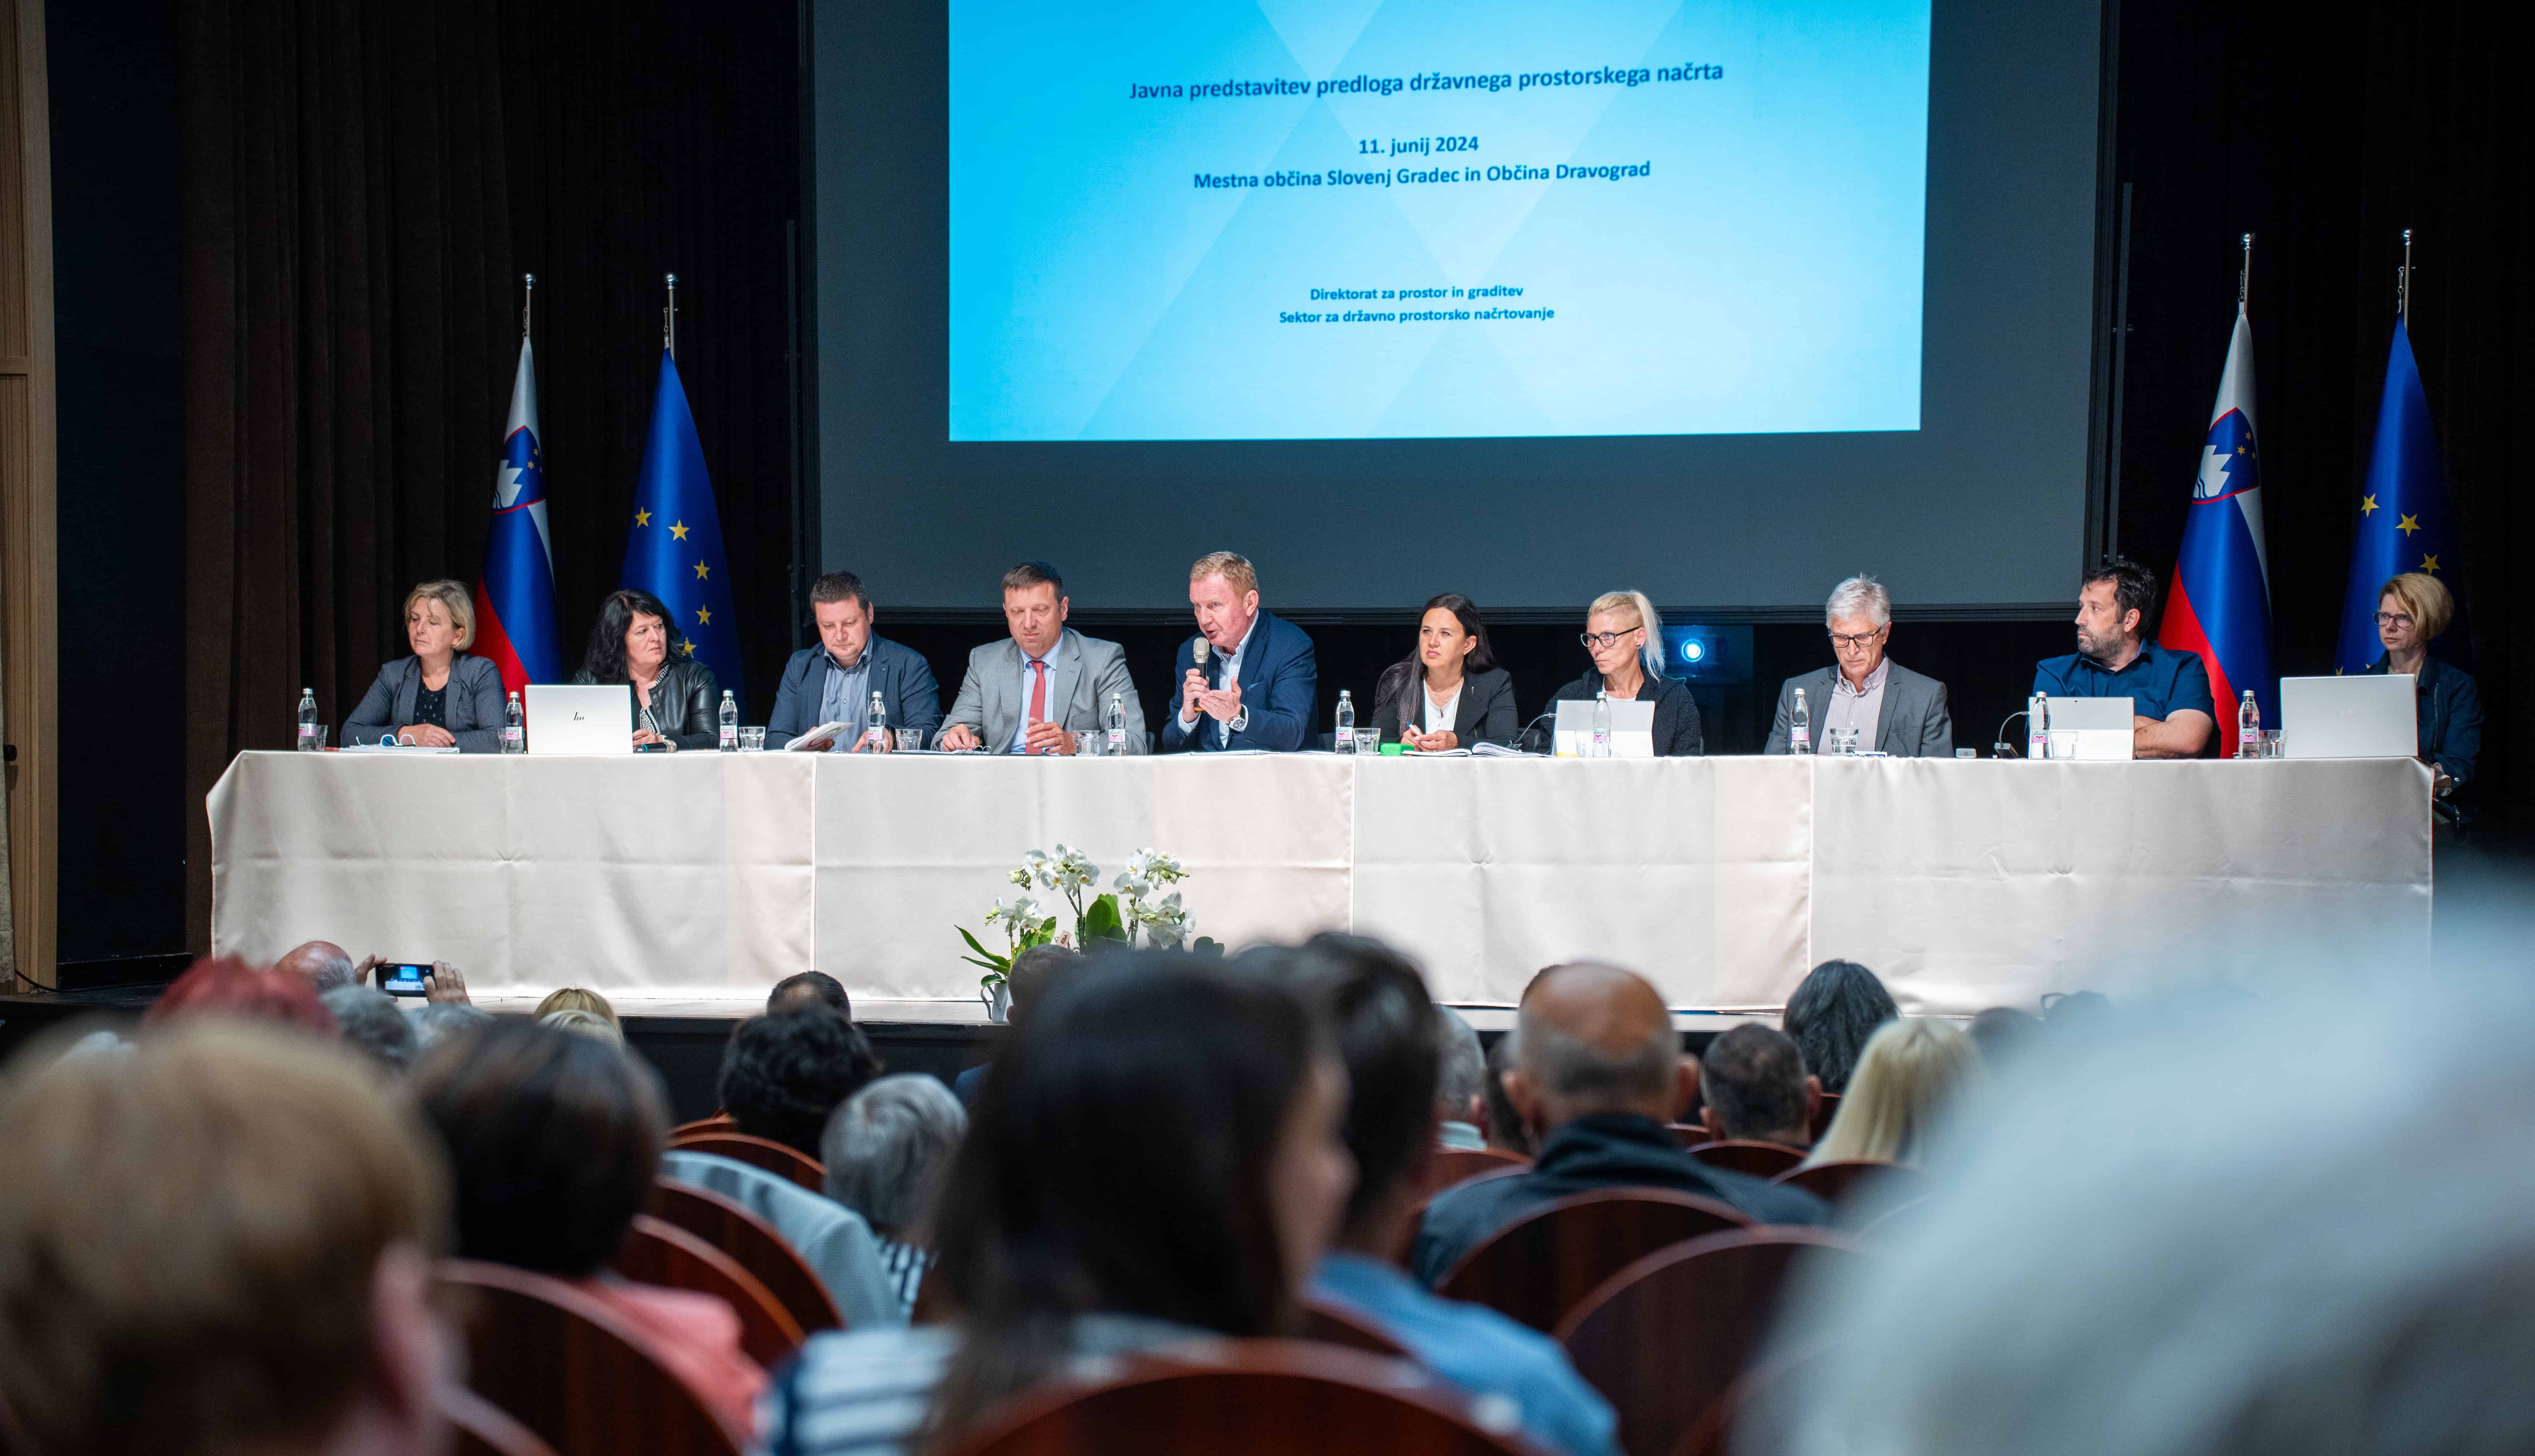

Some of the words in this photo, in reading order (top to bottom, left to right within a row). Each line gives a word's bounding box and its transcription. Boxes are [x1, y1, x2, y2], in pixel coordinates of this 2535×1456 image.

[1129, 83, 1183, 99] Javna
[1190, 78, 1311, 102] predstavitev
[1317, 75, 1403, 98] predloga
[1409, 72, 1512, 92] državnega
[1519, 66, 1650, 91] prostorskega
[1657, 63, 1723, 82] načrta
[1359, 139, 1385, 154] 11.
[1389, 137, 1429, 157] junij
[1435, 136, 1479, 152] 2024
[1194, 173, 1259, 188] Mestna
[1264, 171, 1322, 187] občina
[1327, 169, 1391, 188] Slovenj
[1396, 167, 1459, 184] Gradec
[1465, 167, 1481, 182] in
[1487, 165, 1549, 181] Občina
[1556, 160, 1650, 181] Dravograd
[1310, 288, 1377, 300] Direktorat
[1381, 290, 1395, 299] za
[1399, 288, 1448, 301] prostor
[1452, 286, 1464, 298] in
[1468, 285, 1523, 300] graditev
[1280, 311, 1322, 323] Sektor
[1325, 314, 1339, 322] za
[1343, 310, 1396, 322] državno
[1399, 309, 1470, 324] prostorsko
[1474, 307, 1555, 321] načrtovanje
